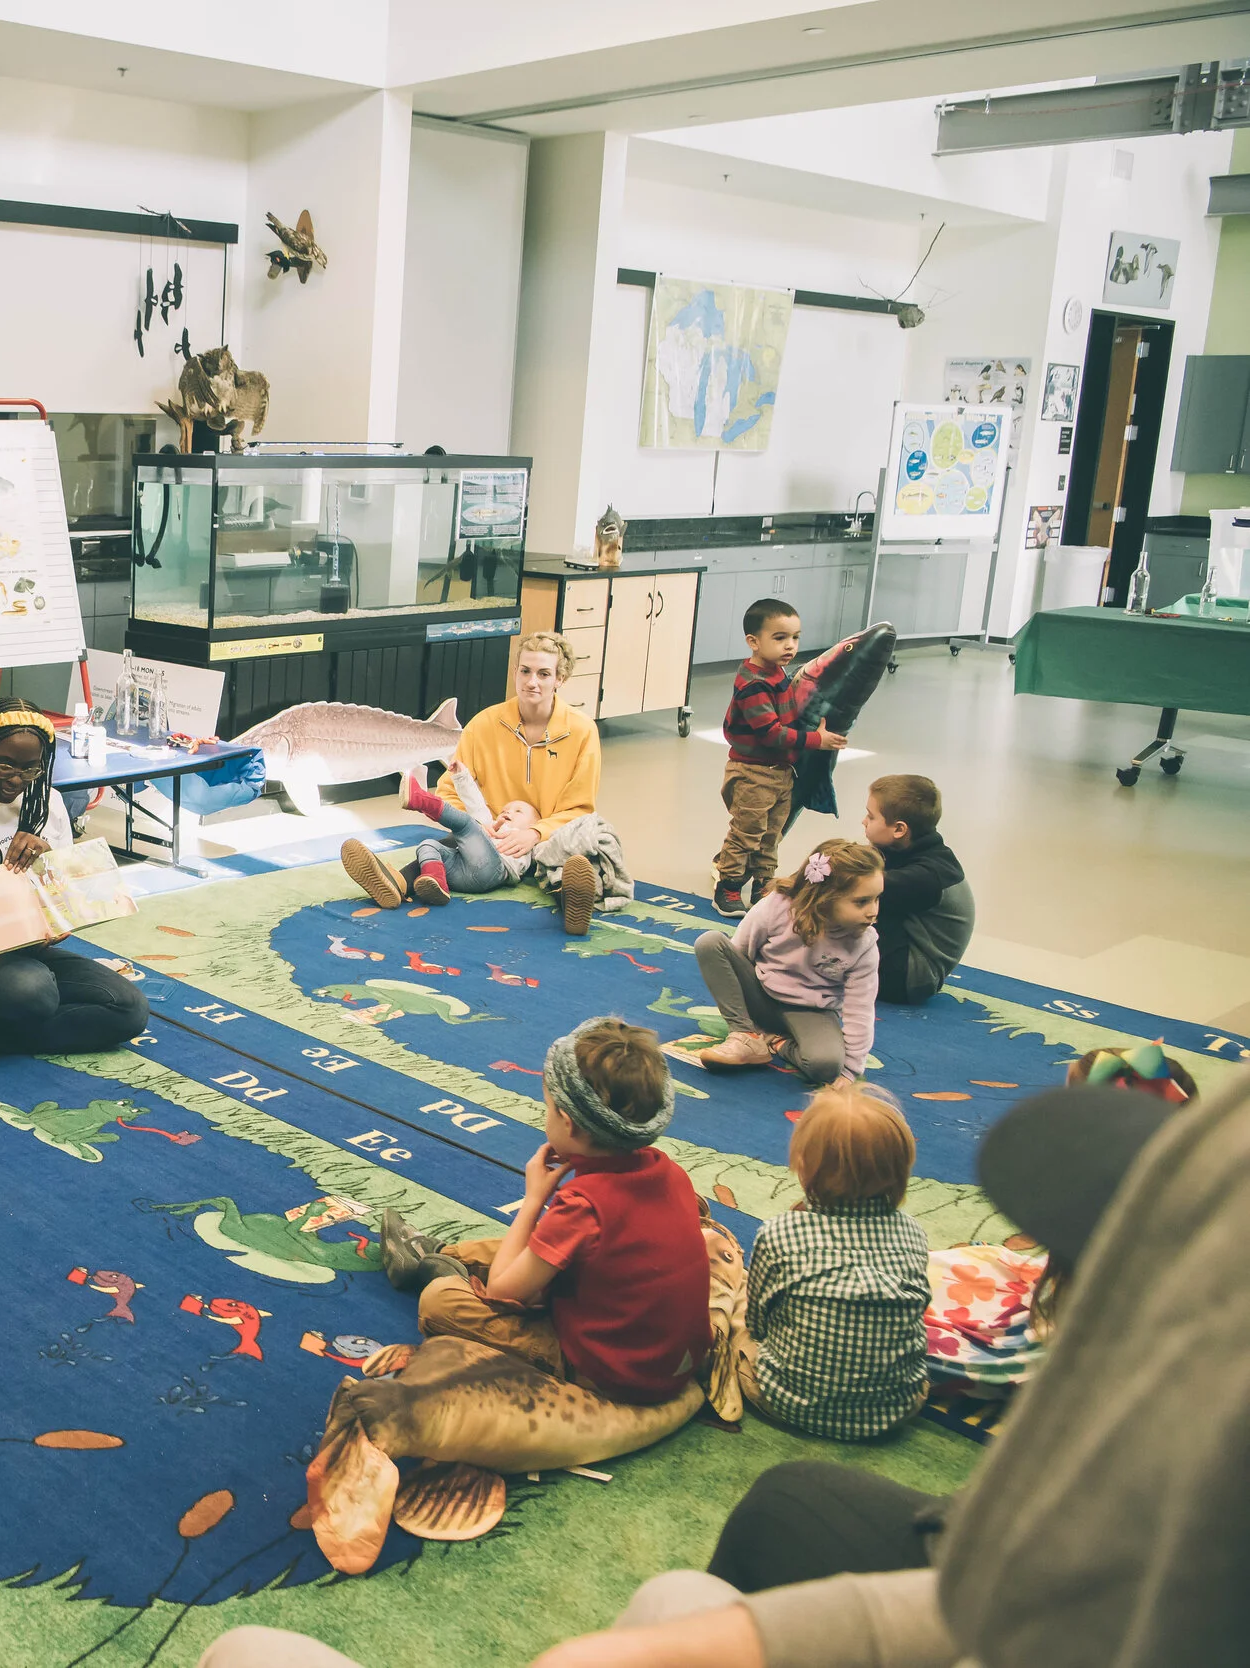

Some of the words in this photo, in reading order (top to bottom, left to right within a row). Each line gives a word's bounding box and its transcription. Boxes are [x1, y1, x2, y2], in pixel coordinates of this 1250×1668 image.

[140, 666, 165, 677] MONS
[646, 894, 696, 911] Pp
[183, 1002, 248, 1025] Ff
[1042, 999, 1100, 1019] Ss
[1203, 1033, 1250, 1059] T
[301, 1047, 363, 1075] Ee
[209, 1070, 289, 1103] Dd
[418, 1099, 507, 1134] Dd
[342, 1128, 413, 1163] Ee
